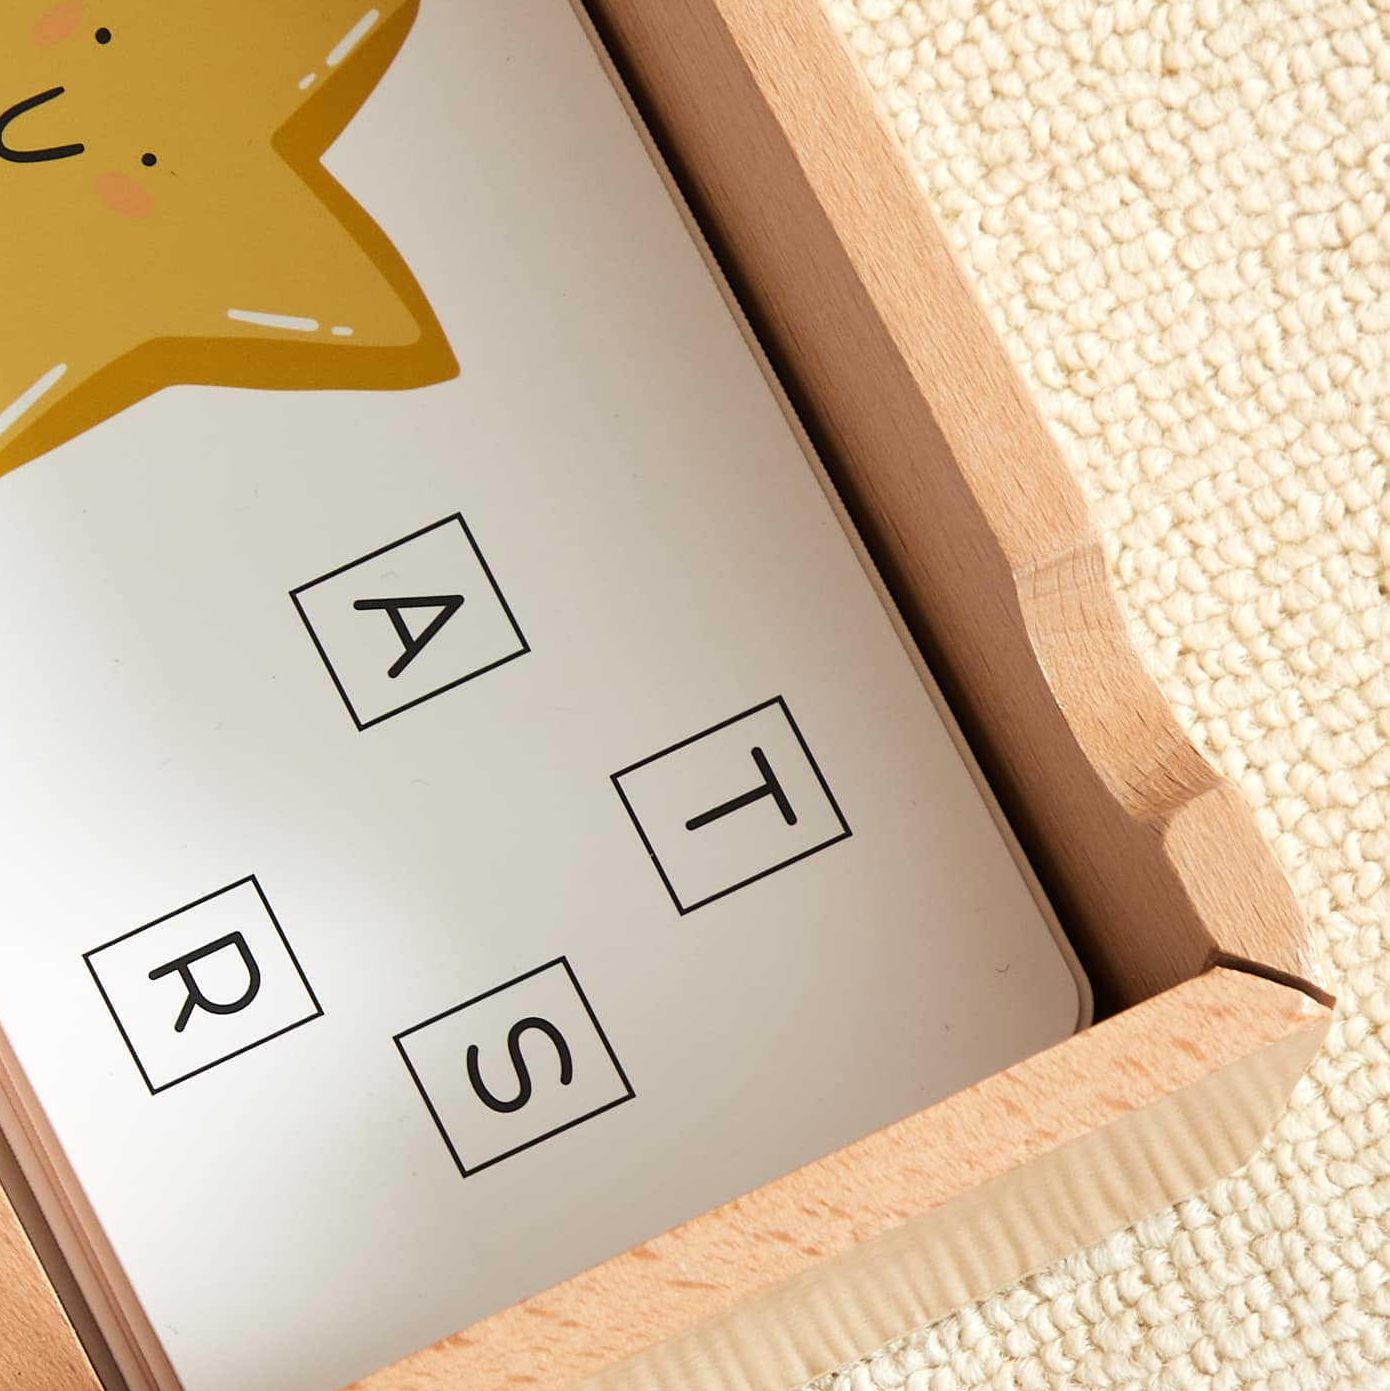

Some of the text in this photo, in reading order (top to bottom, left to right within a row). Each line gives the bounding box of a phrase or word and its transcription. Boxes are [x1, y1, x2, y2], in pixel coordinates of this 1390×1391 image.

[354, 595, 464, 678] A
[686, 747, 797, 830] T
[149, 932, 260, 1032] R
[467, 1017, 572, 1113] S
